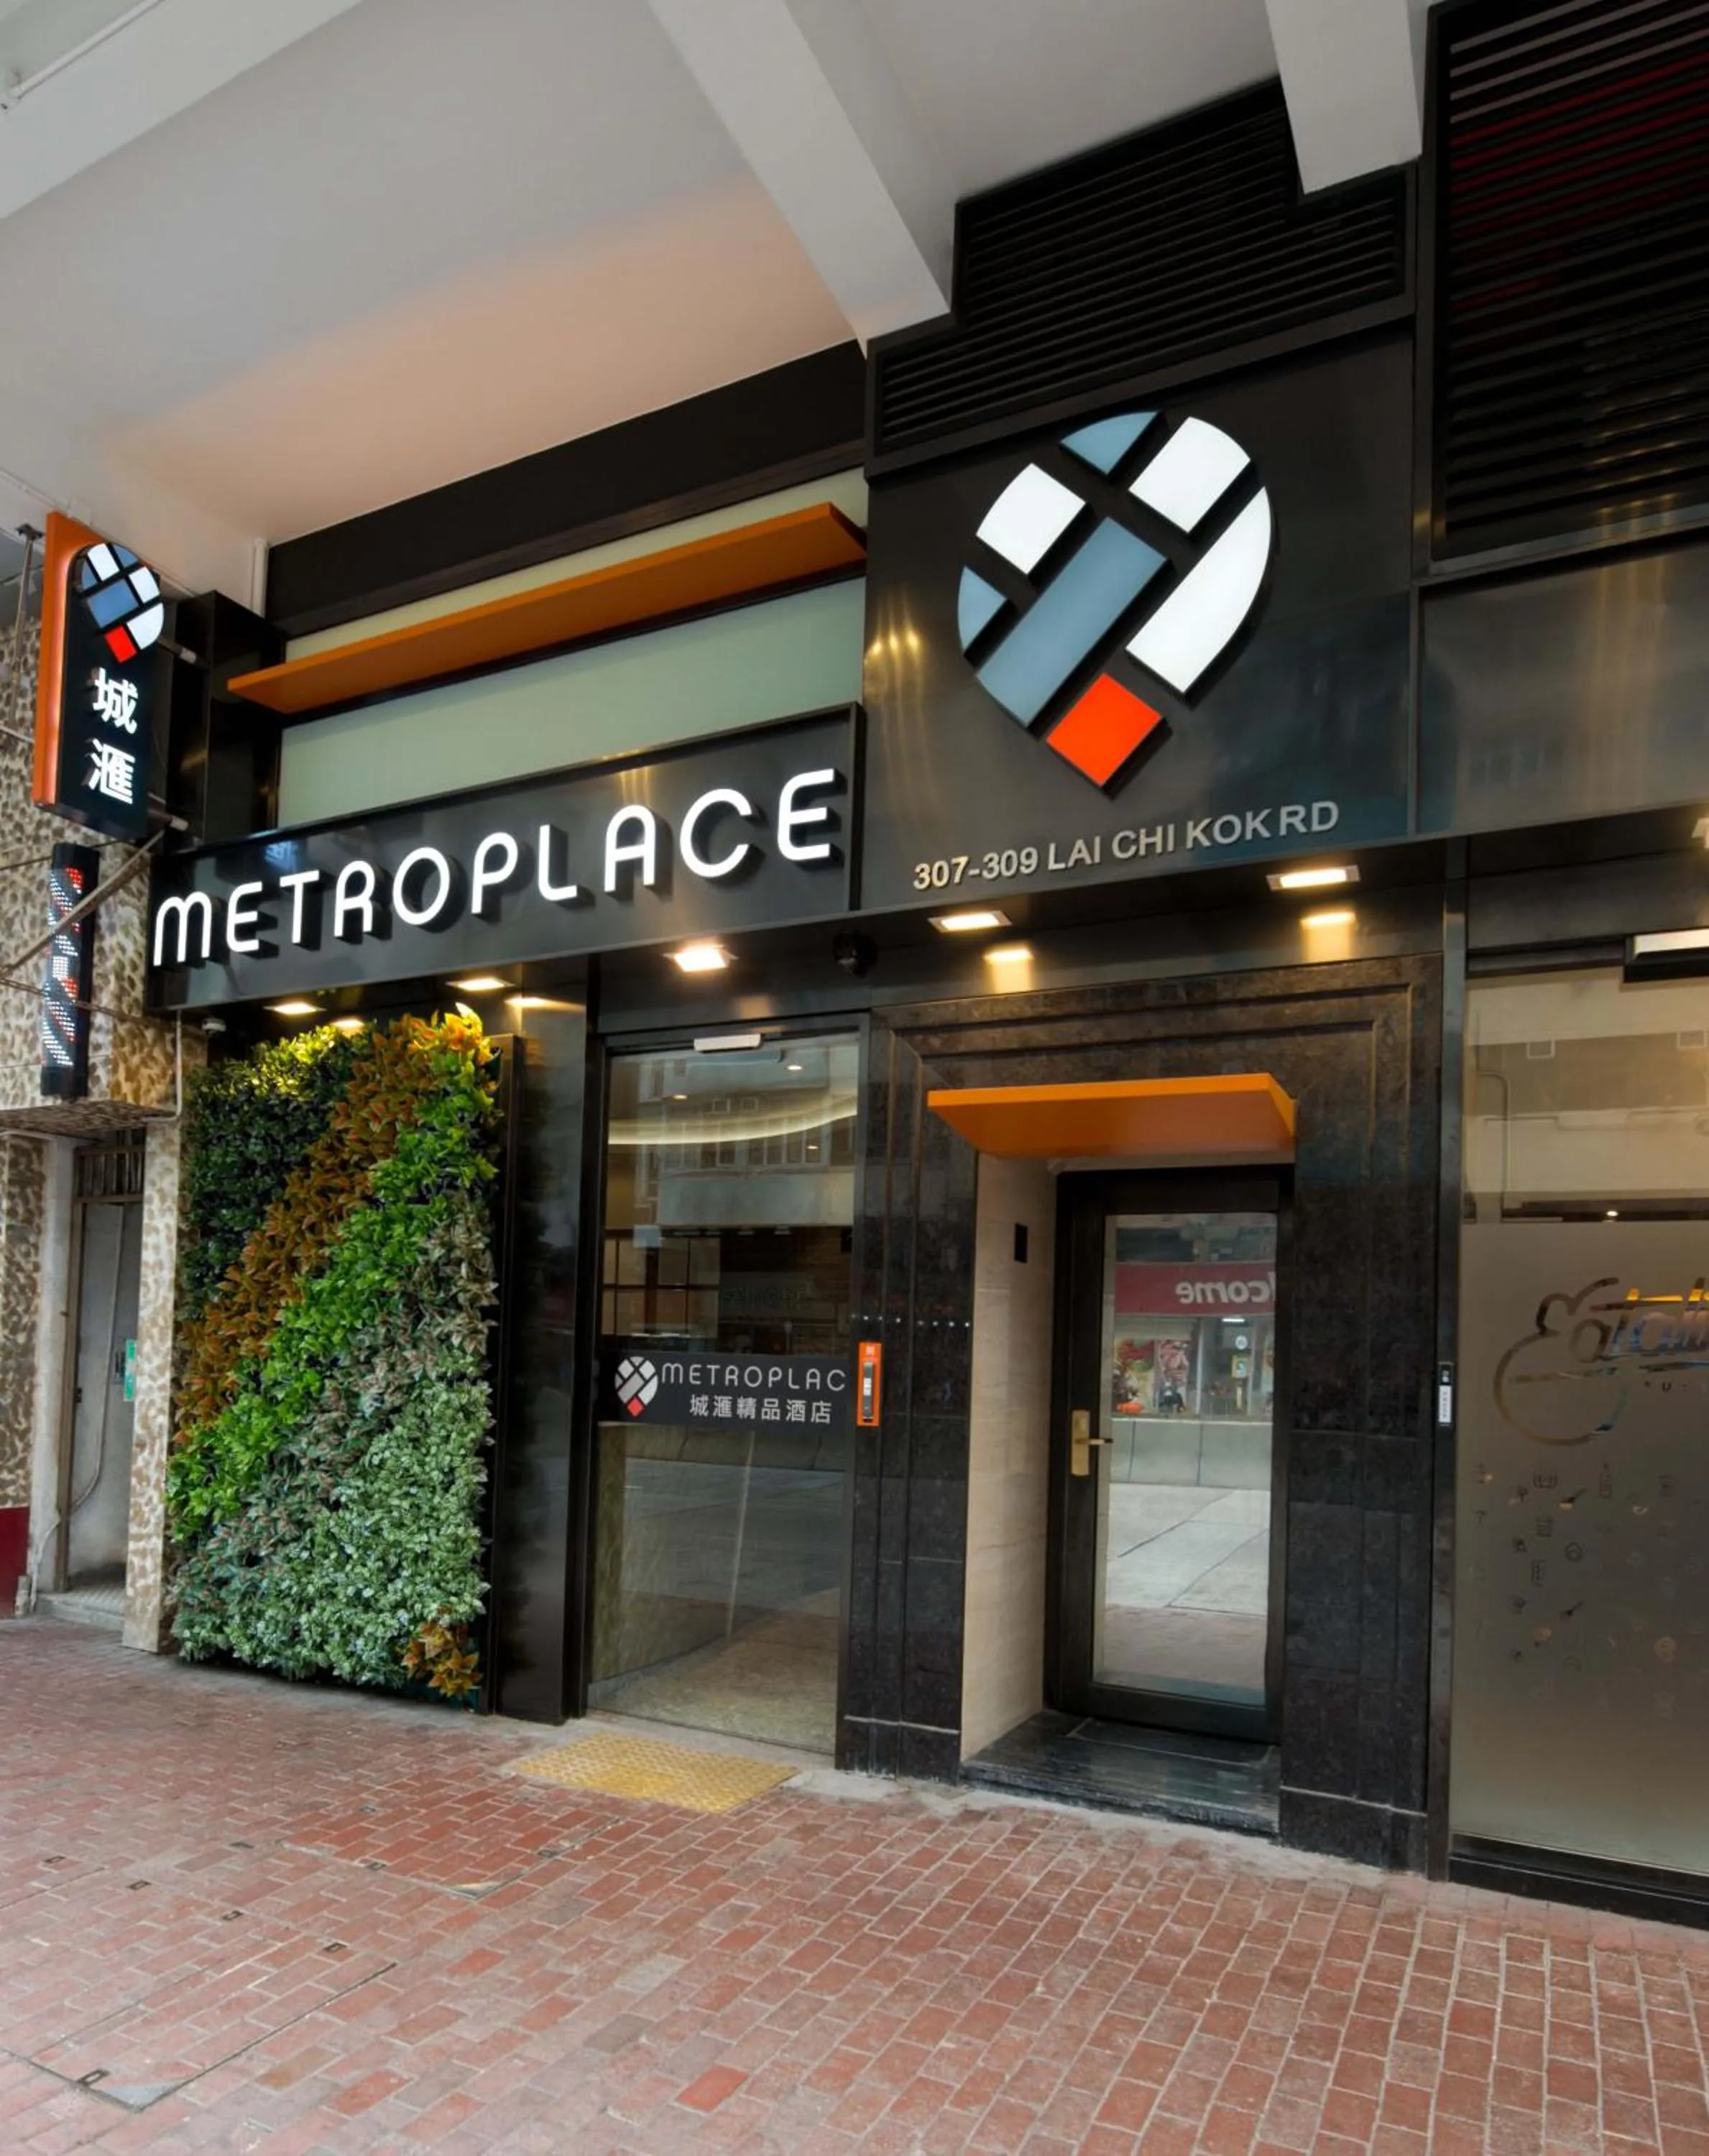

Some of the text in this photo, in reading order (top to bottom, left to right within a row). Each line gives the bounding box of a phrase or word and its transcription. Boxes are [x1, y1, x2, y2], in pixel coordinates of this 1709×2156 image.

[153, 768, 836, 967] METROPLACE
[913, 800, 1340, 890] 307-309 LAI CHI KOK RD
[661, 1363, 847, 1392] METROPLAC
